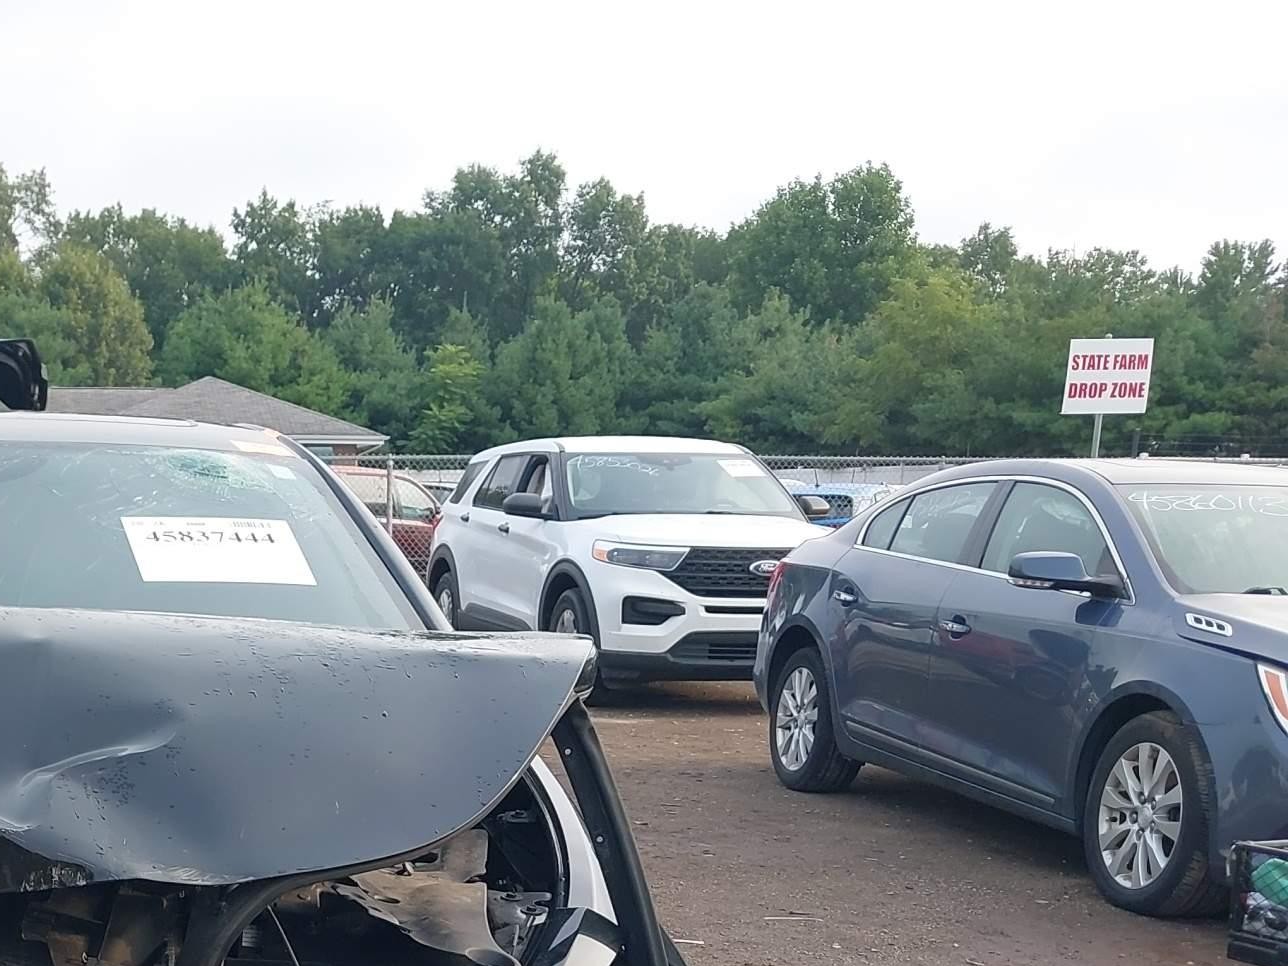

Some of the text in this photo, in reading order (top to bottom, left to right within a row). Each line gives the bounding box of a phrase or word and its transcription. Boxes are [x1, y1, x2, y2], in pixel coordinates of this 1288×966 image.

[1071, 354, 1149, 370] STATE FARM
[1068, 382, 1146, 399] DROP ZONE
[145, 530, 275, 544] 45837444
